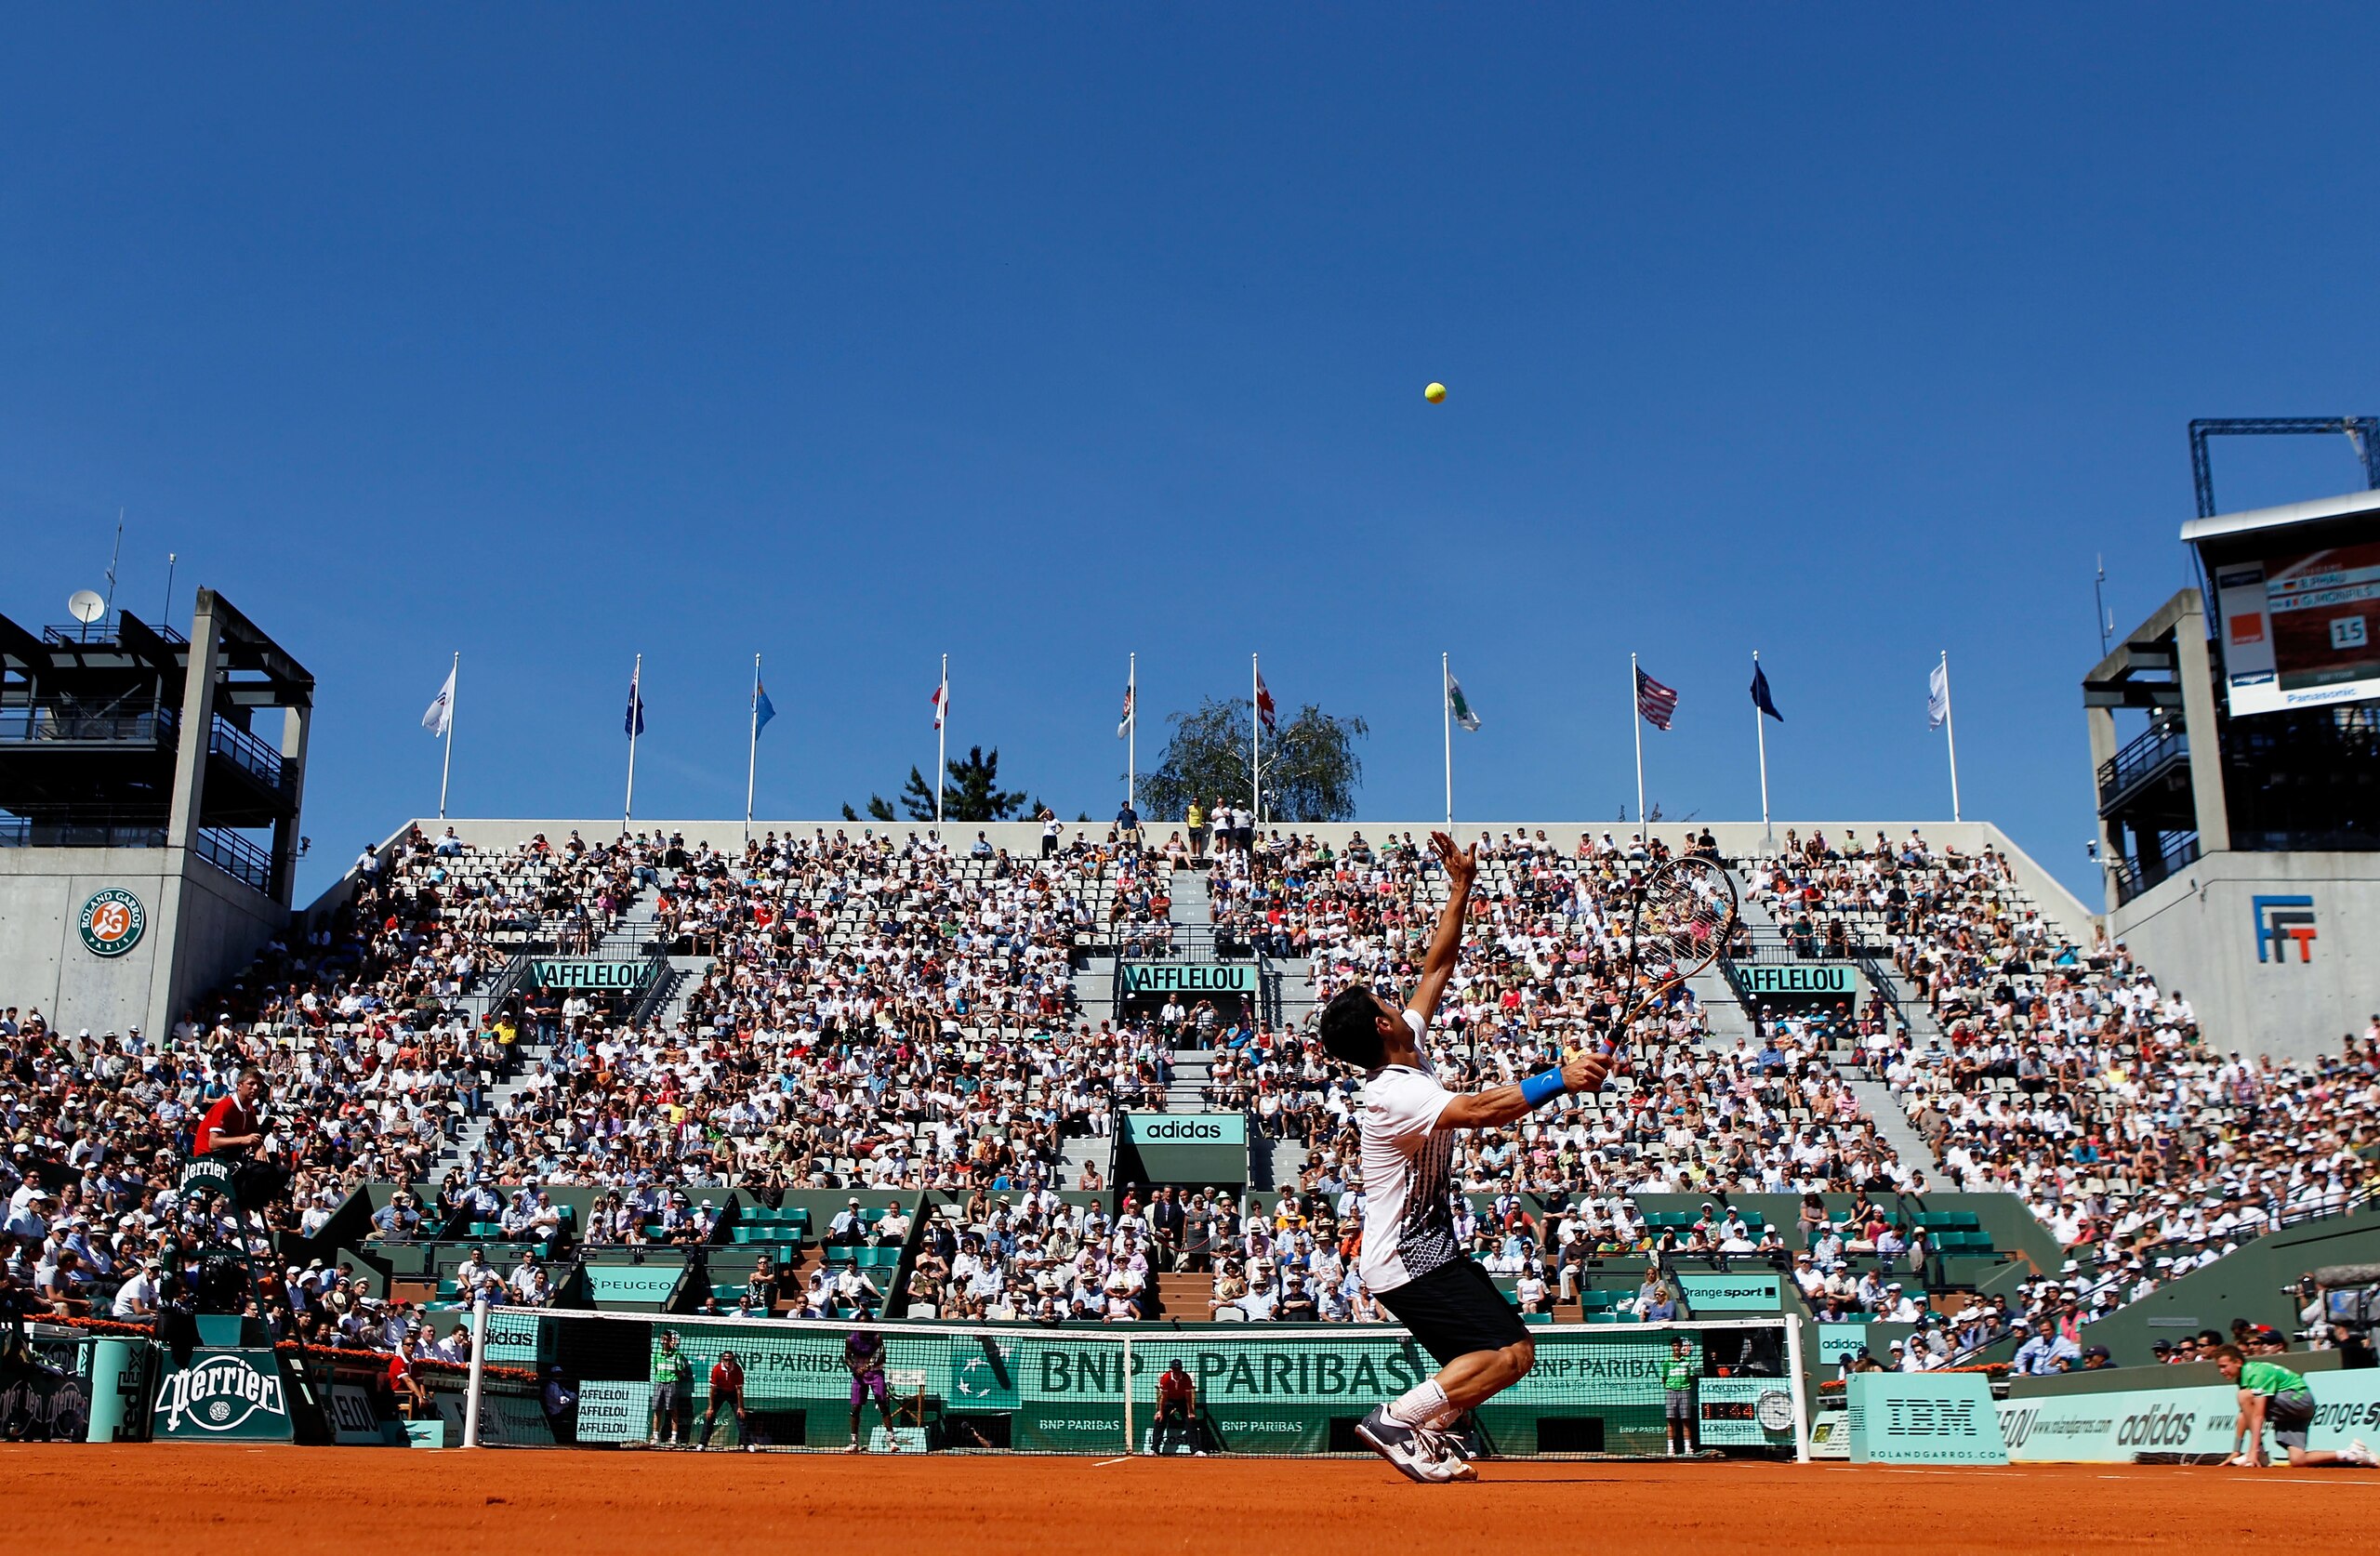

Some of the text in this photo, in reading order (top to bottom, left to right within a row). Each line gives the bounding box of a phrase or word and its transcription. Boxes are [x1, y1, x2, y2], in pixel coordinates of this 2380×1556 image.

[2336, 621, 2364, 642] 15
[81, 892, 141, 929] ROLAND GARROS
[2252, 895, 2317, 963] FFT
[88, 937, 129, 950] PARIS
[544, 965, 648, 986] AFFLELOU
[1136, 968, 1244, 989] AFFLELOU
[1739, 969, 1844, 990] AFFLELOU
[1146, 1121, 1221, 1138] adidas
[1682, 1286, 1762, 1301] Orange sport
[483, 1327, 533, 1346] didas
[1822, 1338, 1864, 1350] adidas
[734, 1352, 853, 1373] NP PARIBA
[1527, 1359, 1661, 1378] BNP PARIBA
[1040, 1352, 1413, 1395] BNP PARIBAS
[579, 1390, 628, 1400] AFFLELOU
[1701, 1384, 1755, 1392] LONGINES
[579, 1406, 628, 1417] AFFLELOU
[1886, 1399, 1977, 1435] IBM
[578, 1423, 628, 1433] AFFLELOU
[1039, 1419, 1119, 1431] BNP PARIBAS
[1222, 1421, 1302, 1432] BNP PARIBAS
[1702, 1424, 1756, 1432] LONGINES
[2118, 1404, 2195, 1446] adidas
[1871, 1450, 2006, 1458] ROLANDGARROS.COM
